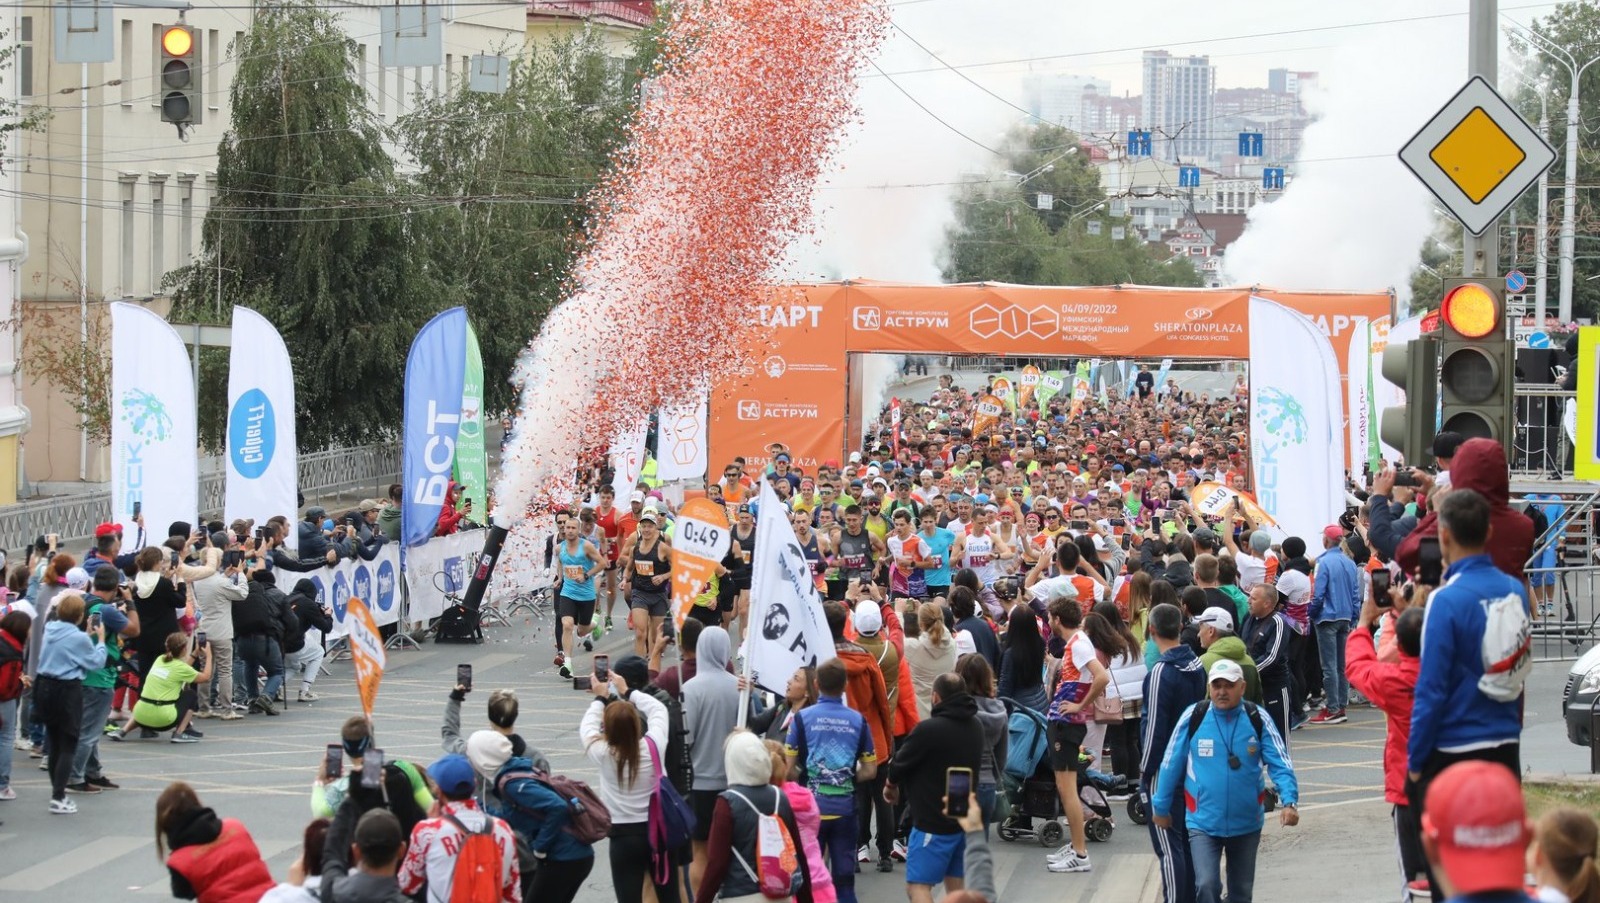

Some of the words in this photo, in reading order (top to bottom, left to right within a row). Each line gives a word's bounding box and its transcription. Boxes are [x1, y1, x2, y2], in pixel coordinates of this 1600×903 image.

[1061, 304, 1118, 314] 04/09/2022
[743, 304, 823, 328] ТАРТ
[1062, 316, 1104, 324] УФИМСКИЙ
[884, 316, 949, 328] АСТРУМ
[1062, 325, 1129, 334] МЕЖДУНАРОДНЫЙ
[1153, 322, 1243, 333] SHERATONPLAZA
[1062, 334, 1098, 343] МАРАФОН
[763, 408, 818, 418] АСТРУМ
[413, 399, 460, 506] БСТ
[683, 521, 719, 548] 0:49
